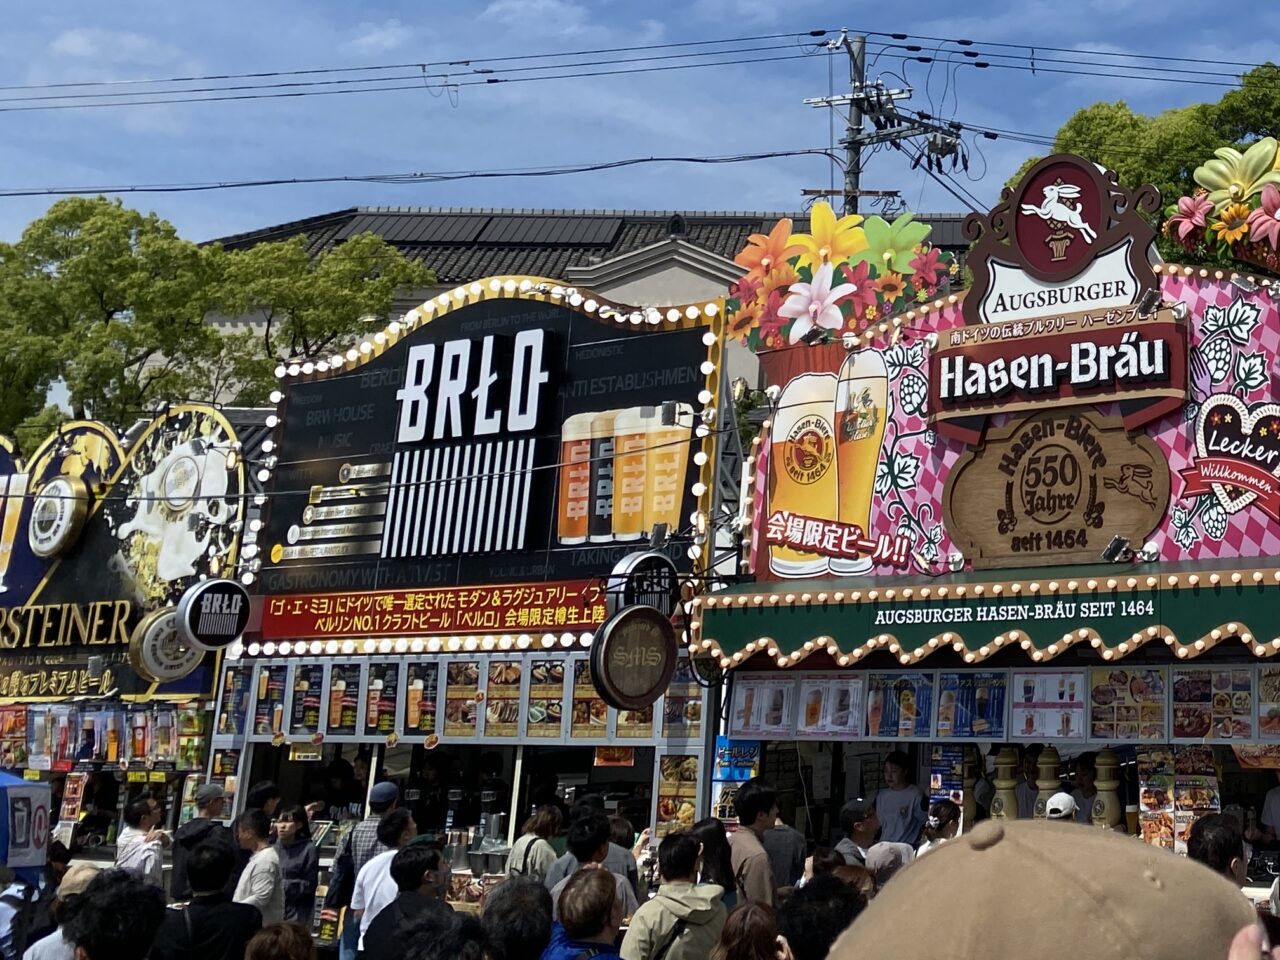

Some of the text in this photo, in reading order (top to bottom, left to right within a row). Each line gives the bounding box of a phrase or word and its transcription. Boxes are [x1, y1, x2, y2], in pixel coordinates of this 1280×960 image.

[992, 280, 1128, 314] AUGSBURGER
[950, 319, 1077, 345] 南ドイツの伝統ブルワリー
[939, 331, 1164, 398] Hasen-Bräu
[590, 365, 698, 395] ESTABLISHMEN
[788, 419, 830, 443] Hasen-Biere
[998, 415, 1106, 476] Hasen-Biere
[1208, 429, 1279, 464] Lecker
[807, 463, 826, 482] 1464
[1024, 453, 1078, 488] 550
[1200, 463, 1273, 494] Willkommen
[1024, 490, 1076, 518] Jahre
[767, 513, 909, 561] 会場限定ビール!!
[1046, 528, 1088, 550] 1464
[874, 600, 1154, 626] AUGSBURGER HASEN-BRÄU SEIT 1464
